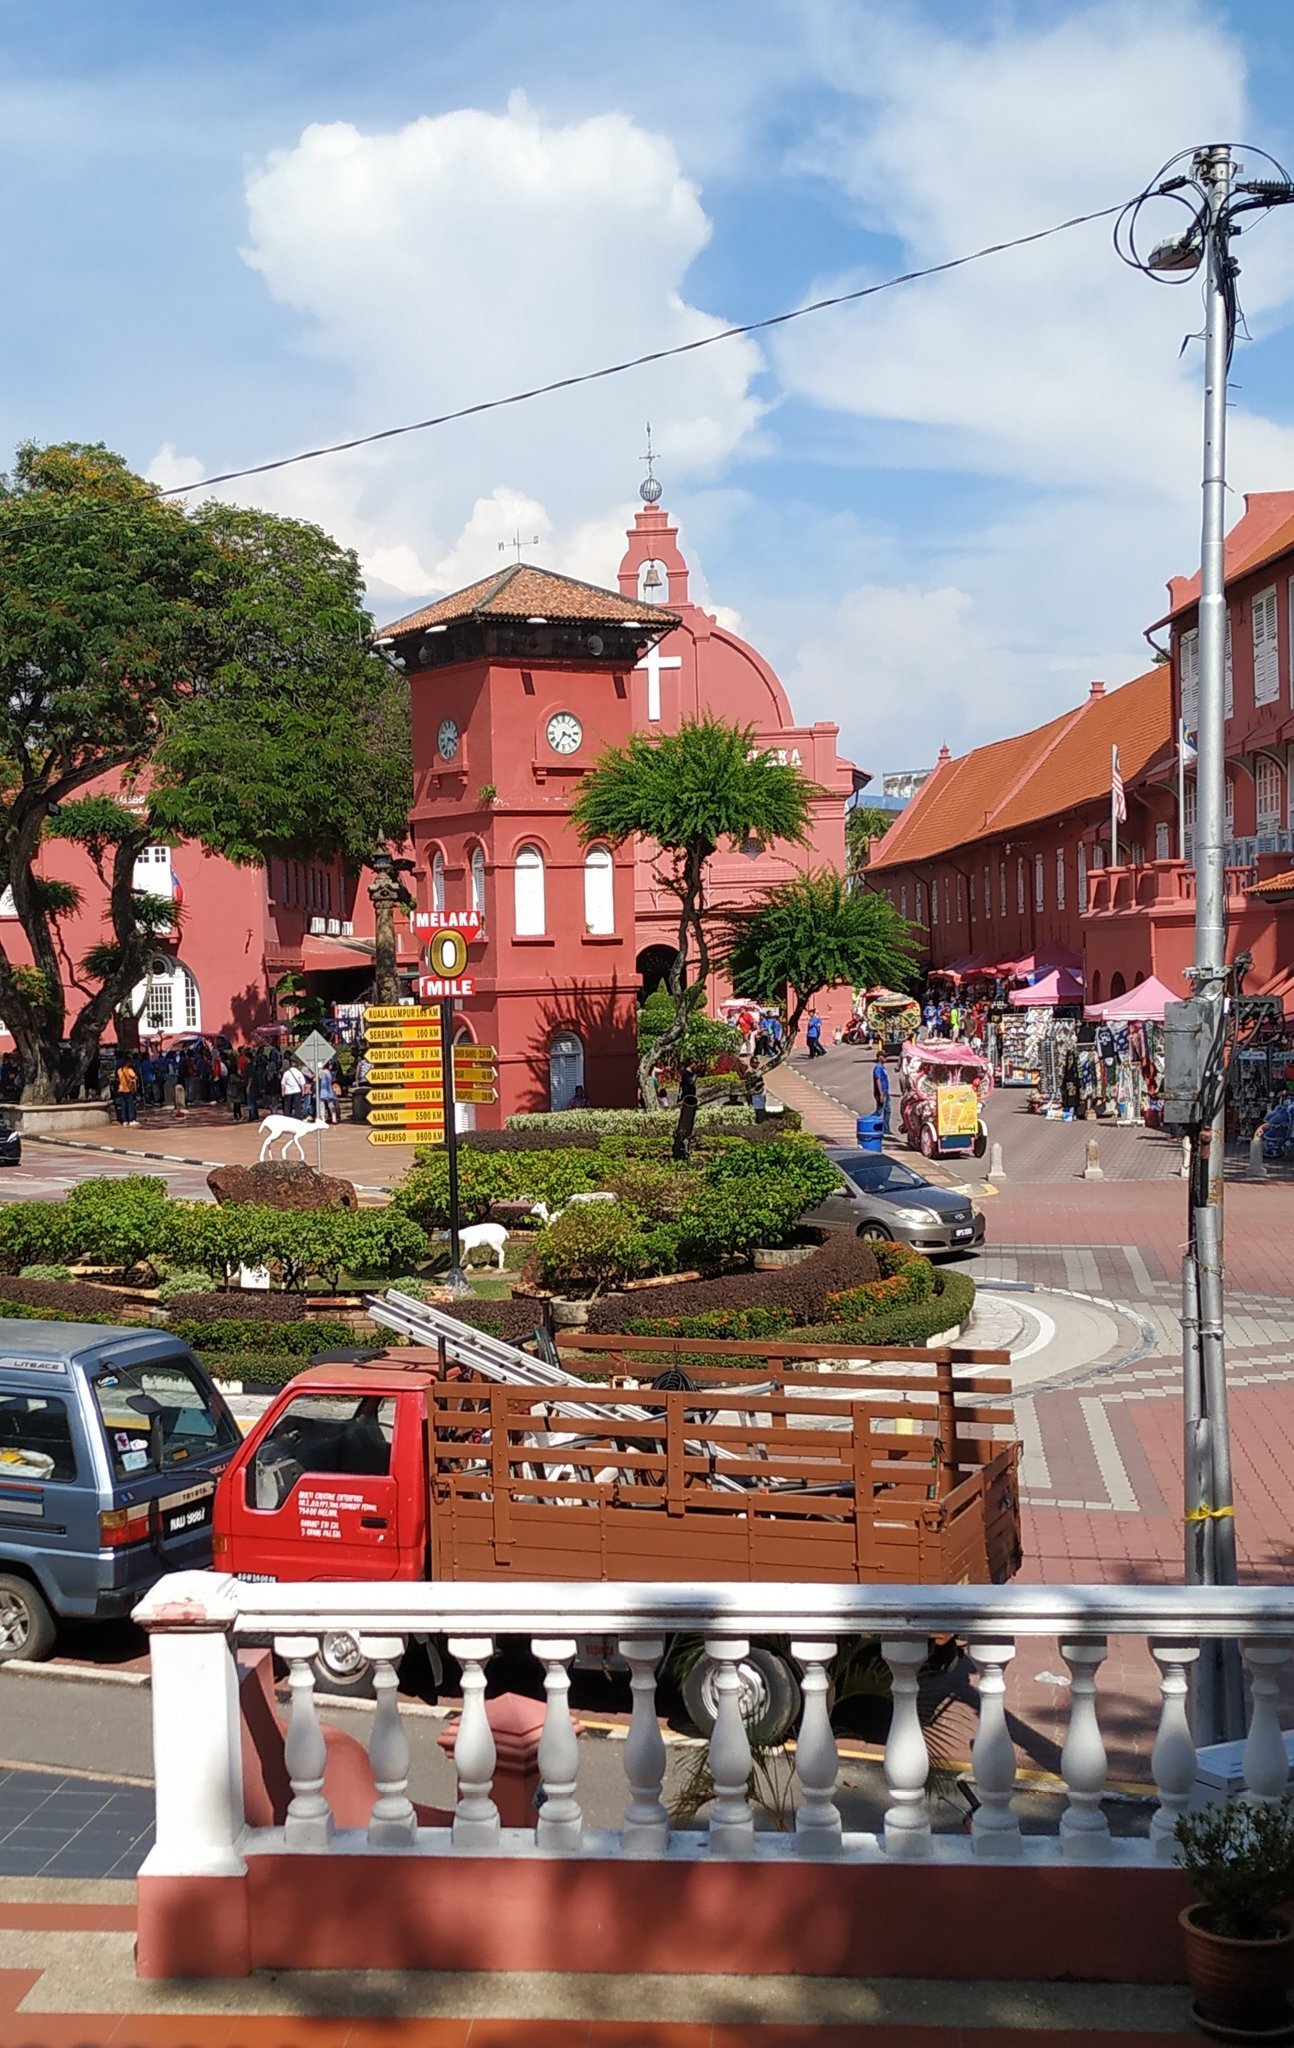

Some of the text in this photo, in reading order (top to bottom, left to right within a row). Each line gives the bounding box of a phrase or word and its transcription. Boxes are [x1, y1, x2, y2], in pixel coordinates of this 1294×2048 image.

[416, 912, 479, 927] MELAKA
[426, 980, 472, 995] MILE
[368, 1009, 389, 1019] KUALA
[389, 1008, 415, 1018] LUMPUR
[428, 1007, 439, 1017] KM
[369, 1028, 439, 1040] SEREMBAN 100 KM
[370, 1050, 386, 1060] PORT
[387, 1049, 415, 1060] DICKSON
[429, 1048, 440, 1058] KM
[371, 1071, 394, 1081] MASJID
[394, 1070, 415, 1080] TANAH
[430, 1069, 441, 1079] KM
[371, 1090, 442, 1101] MEKAH 6550 KM
[372, 1110, 443, 1122] NANJING 5500 KM
[373, 1132, 407, 1143] VALPERISO
[433, 1131, 443, 1141] KM
[182, 1487, 207, 1501] TOYOTA
